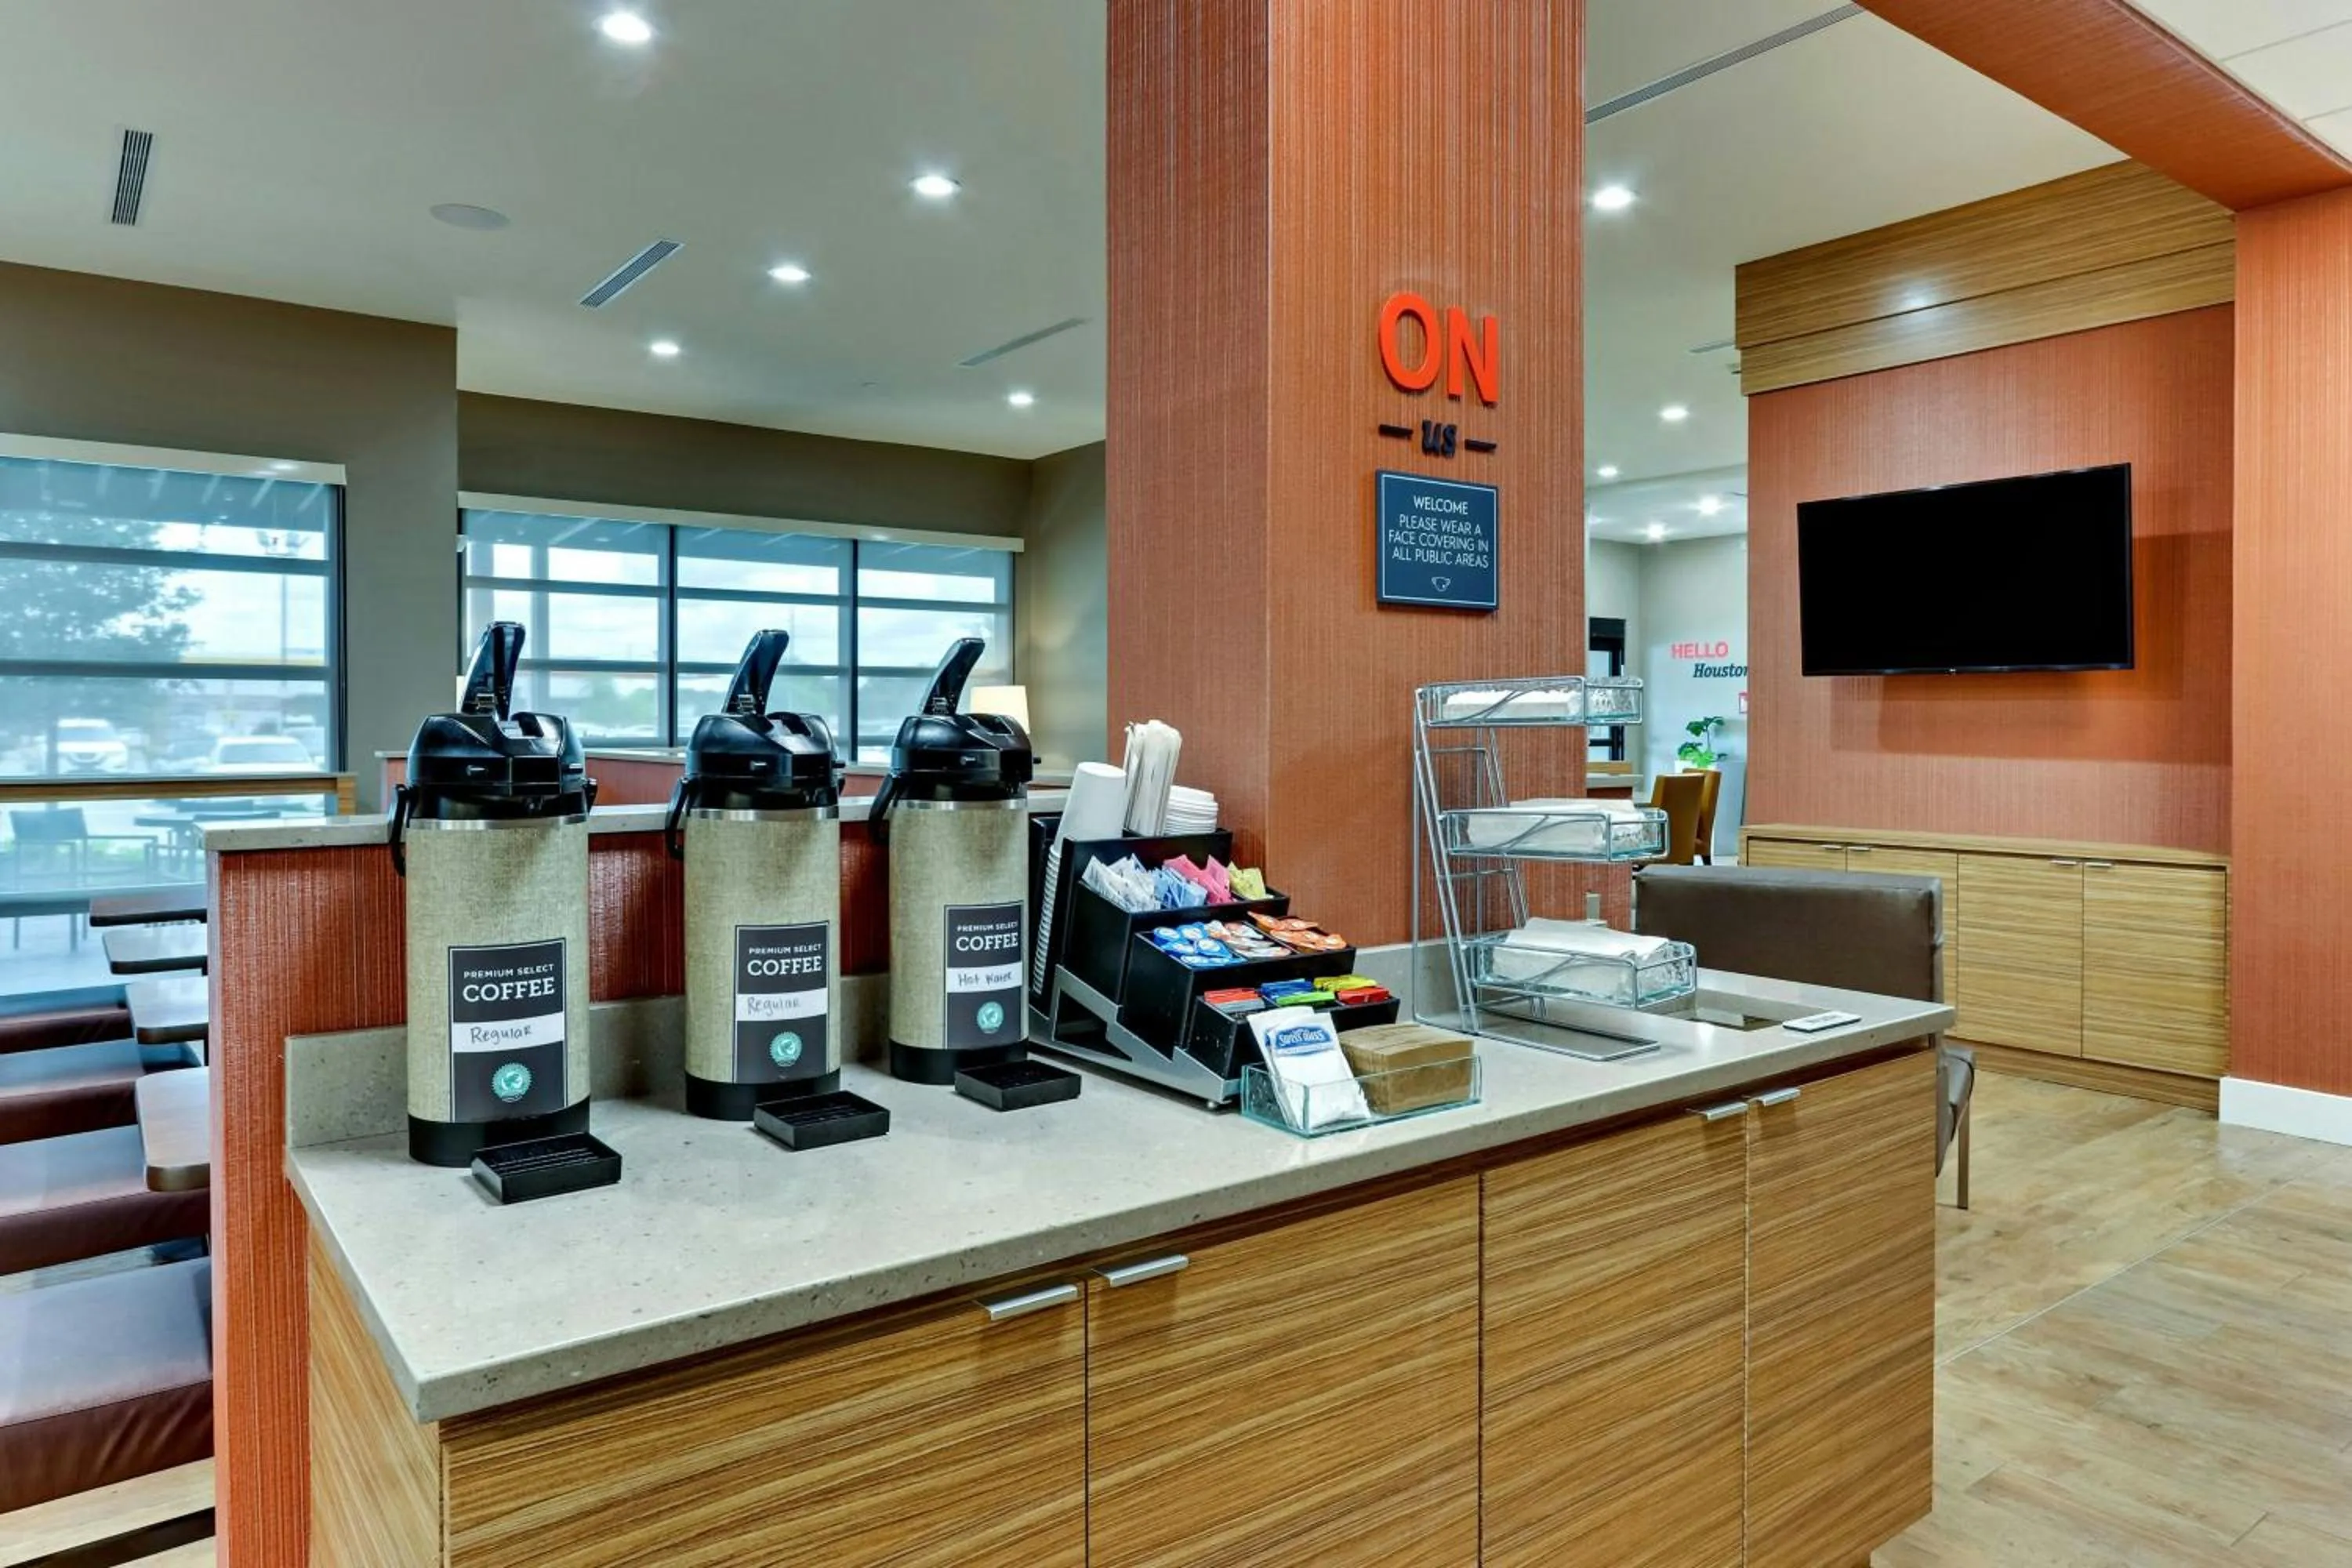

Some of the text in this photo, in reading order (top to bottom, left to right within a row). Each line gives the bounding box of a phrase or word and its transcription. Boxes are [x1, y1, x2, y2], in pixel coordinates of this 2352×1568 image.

[1379, 291, 1498, 406] ON
[1414, 495, 1468, 515] WELCOME
[1399, 514, 1482, 535] PLEASE WEAR A
[1388, 529, 1489, 553] FACE COVERING IN
[1392, 546, 1489, 568] ALL PUBLIC AREAS
[1671, 641, 1729, 659] HELLO
[956, 924, 994, 932] PREMIUM
[749, 943, 822, 955] PREMIUM SELECT
[956, 932, 1018, 952] COFFEE
[463, 964, 555, 978] PREMIUM SELECT
[747, 956, 822, 976] COFFEE
[463, 977, 555, 1003] COFFEE
